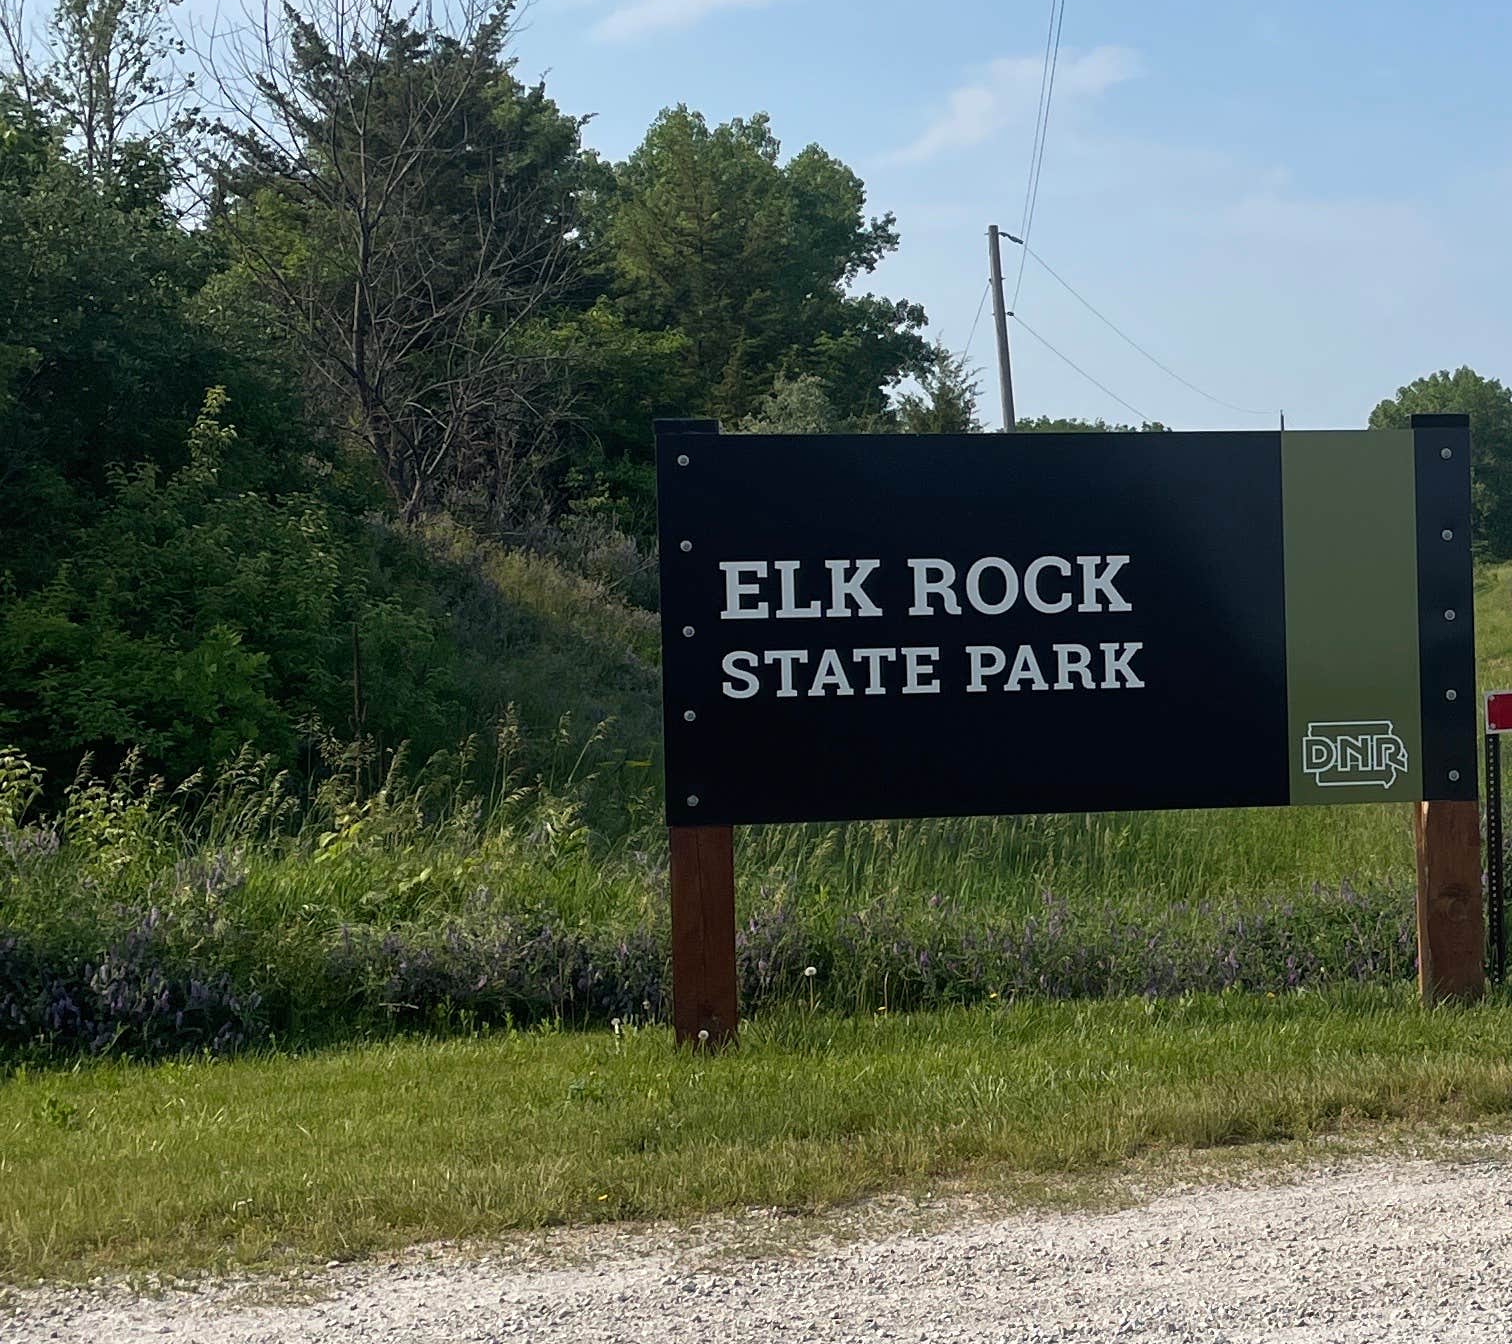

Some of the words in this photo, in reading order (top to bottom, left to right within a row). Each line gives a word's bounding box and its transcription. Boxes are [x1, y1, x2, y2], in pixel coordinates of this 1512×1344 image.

[719, 558, 883, 620] ELK
[907, 555, 1133, 616] ROCK
[721, 646, 941, 699] STATE
[965, 641, 1145, 693] PARK
[1302, 734, 1408, 773] DNR
